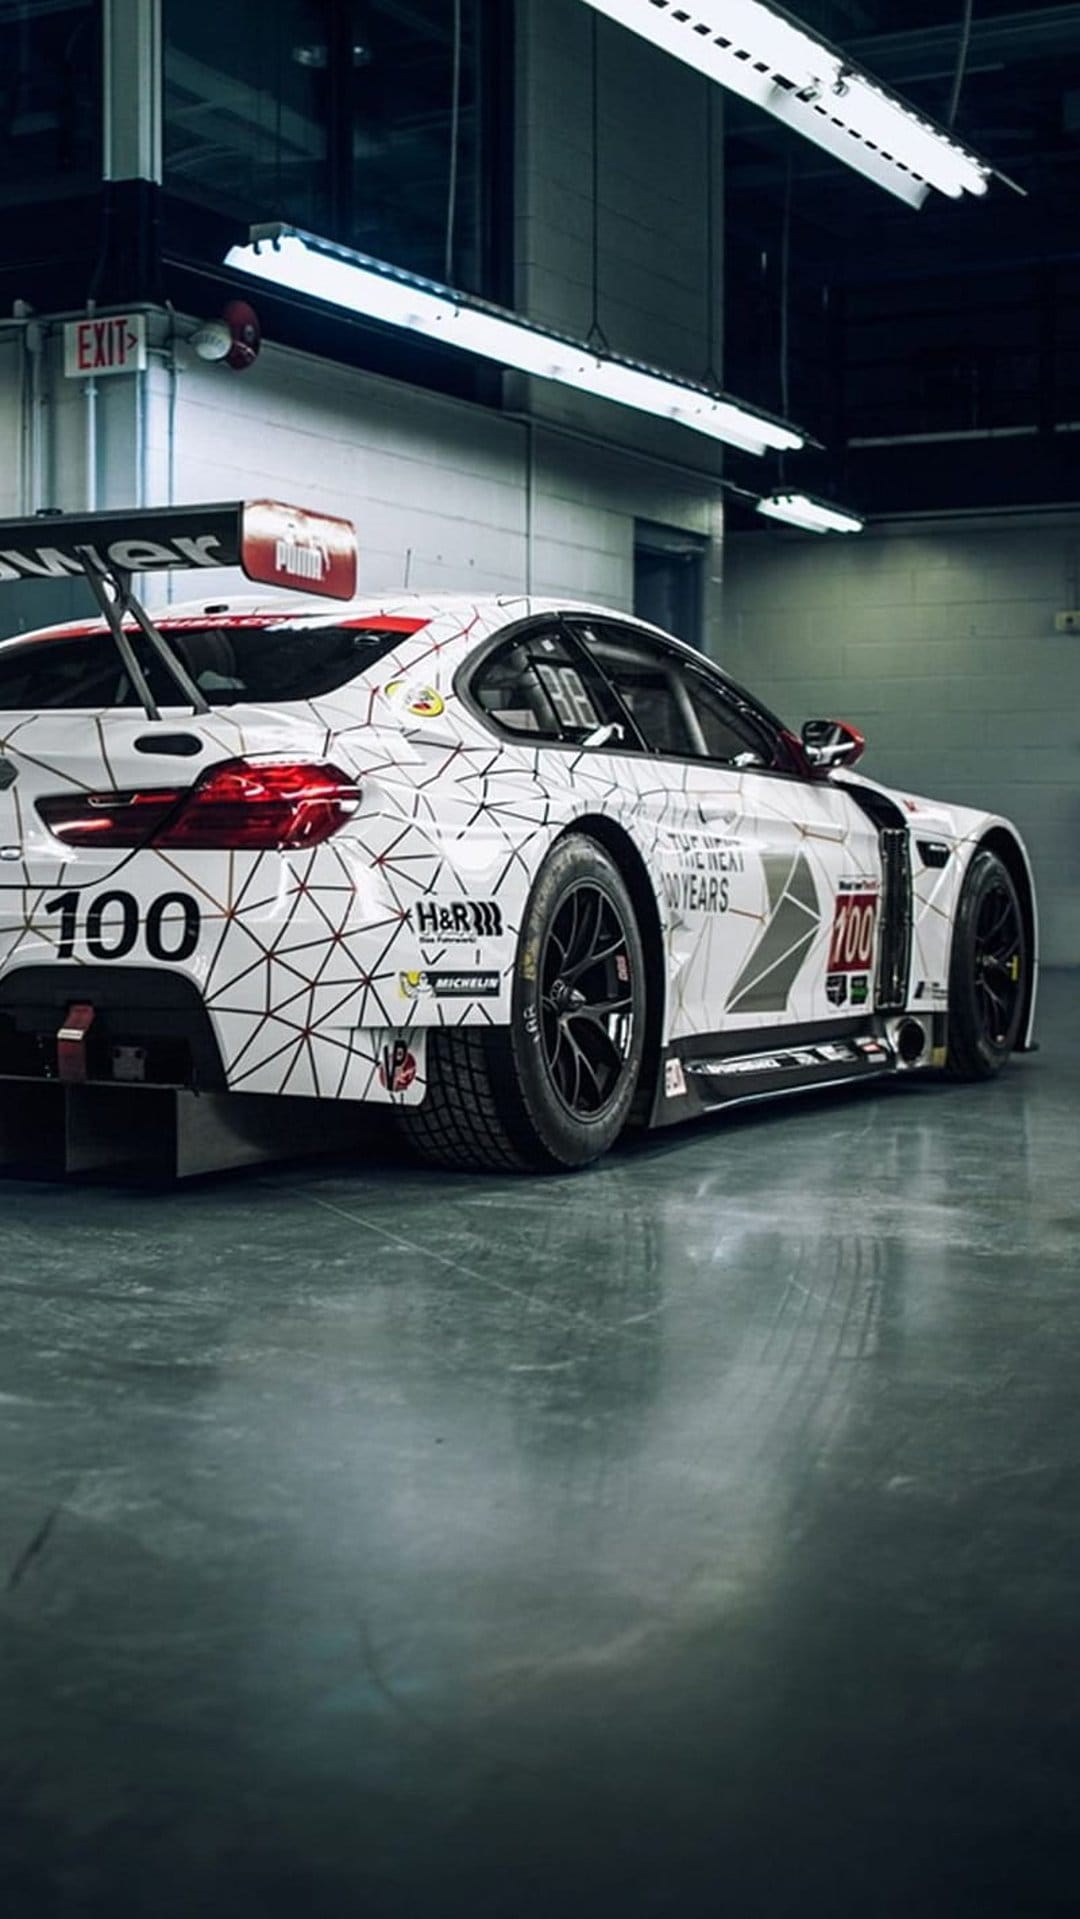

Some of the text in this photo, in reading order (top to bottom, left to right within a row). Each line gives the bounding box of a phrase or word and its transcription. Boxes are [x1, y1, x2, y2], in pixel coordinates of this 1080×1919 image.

[77, 320, 128, 370] EXIT
[416, 902, 471, 932] H&R
[681, 874, 729, 912] YEARS
[45, 890, 200, 961] 100
[834, 905, 874, 963] 100
[435, 977, 499, 988] MICHELIN
[383, 1040, 408, 1091] VP
